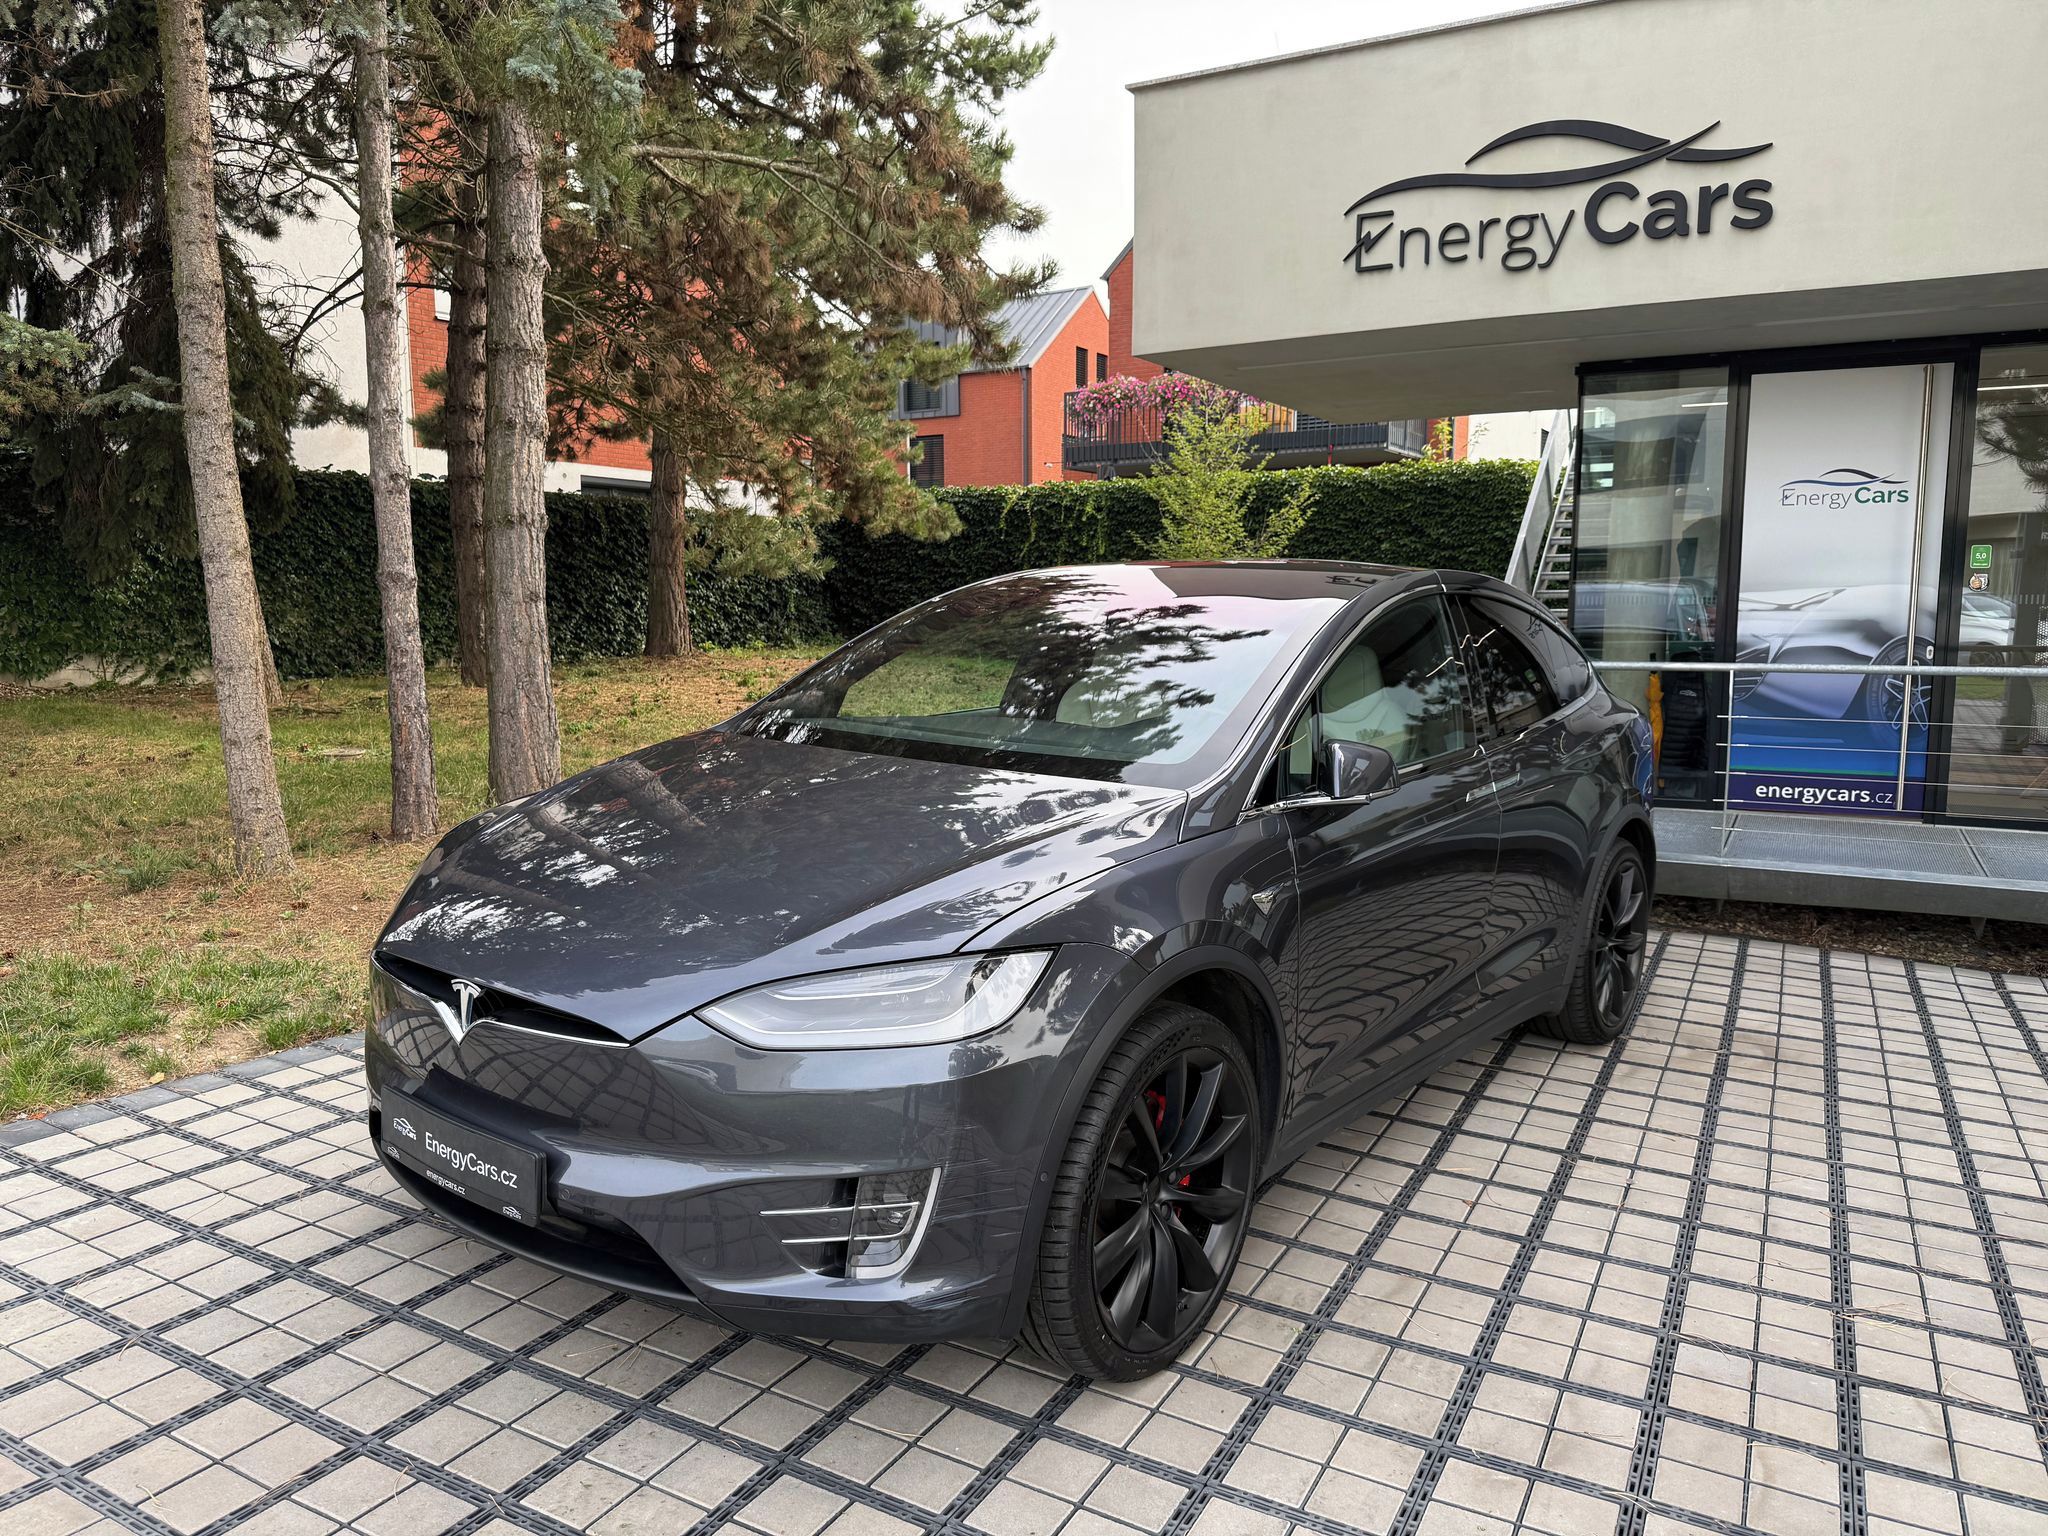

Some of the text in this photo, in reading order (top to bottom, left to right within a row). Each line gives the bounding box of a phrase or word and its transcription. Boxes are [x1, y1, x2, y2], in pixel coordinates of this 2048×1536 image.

[1346, 179, 1774, 272] EnergyCars
[1781, 487, 1909, 509] EnergyCars
[1755, 785, 1893, 804] energycars.cz
[425, 1131, 518, 1189] EnergyCars.cz
[426, 1169, 466, 1195] energycars.cz
